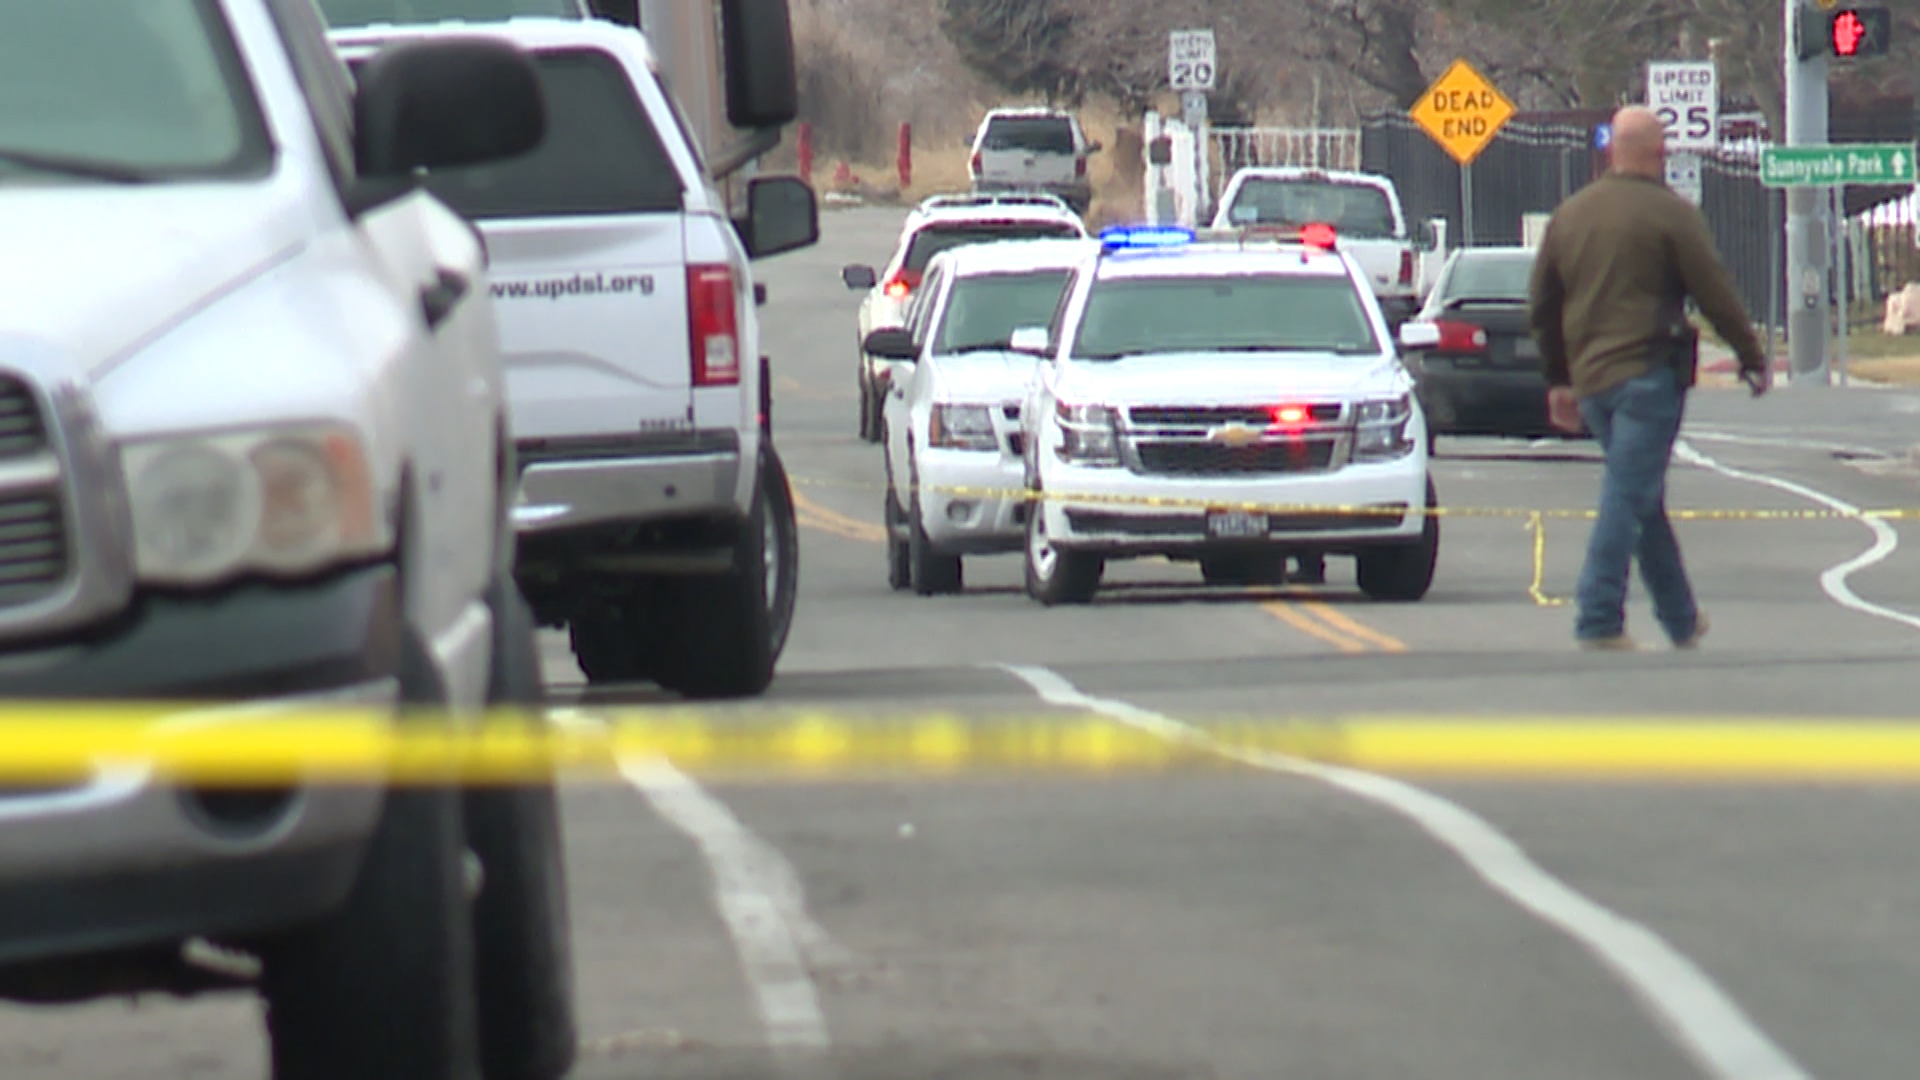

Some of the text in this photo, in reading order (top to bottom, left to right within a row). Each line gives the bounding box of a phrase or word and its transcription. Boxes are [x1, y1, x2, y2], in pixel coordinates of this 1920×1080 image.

[1174, 63, 1212, 84] 20
[1654, 70, 1711, 86] SPEED
[1433, 90, 1495, 112] DEAD
[1659, 89, 1705, 103] LIMIT
[1443, 117, 1487, 139] END
[1656, 106, 1711, 139] 25
[1767, 152, 1884, 182] Sunnyvale Park
